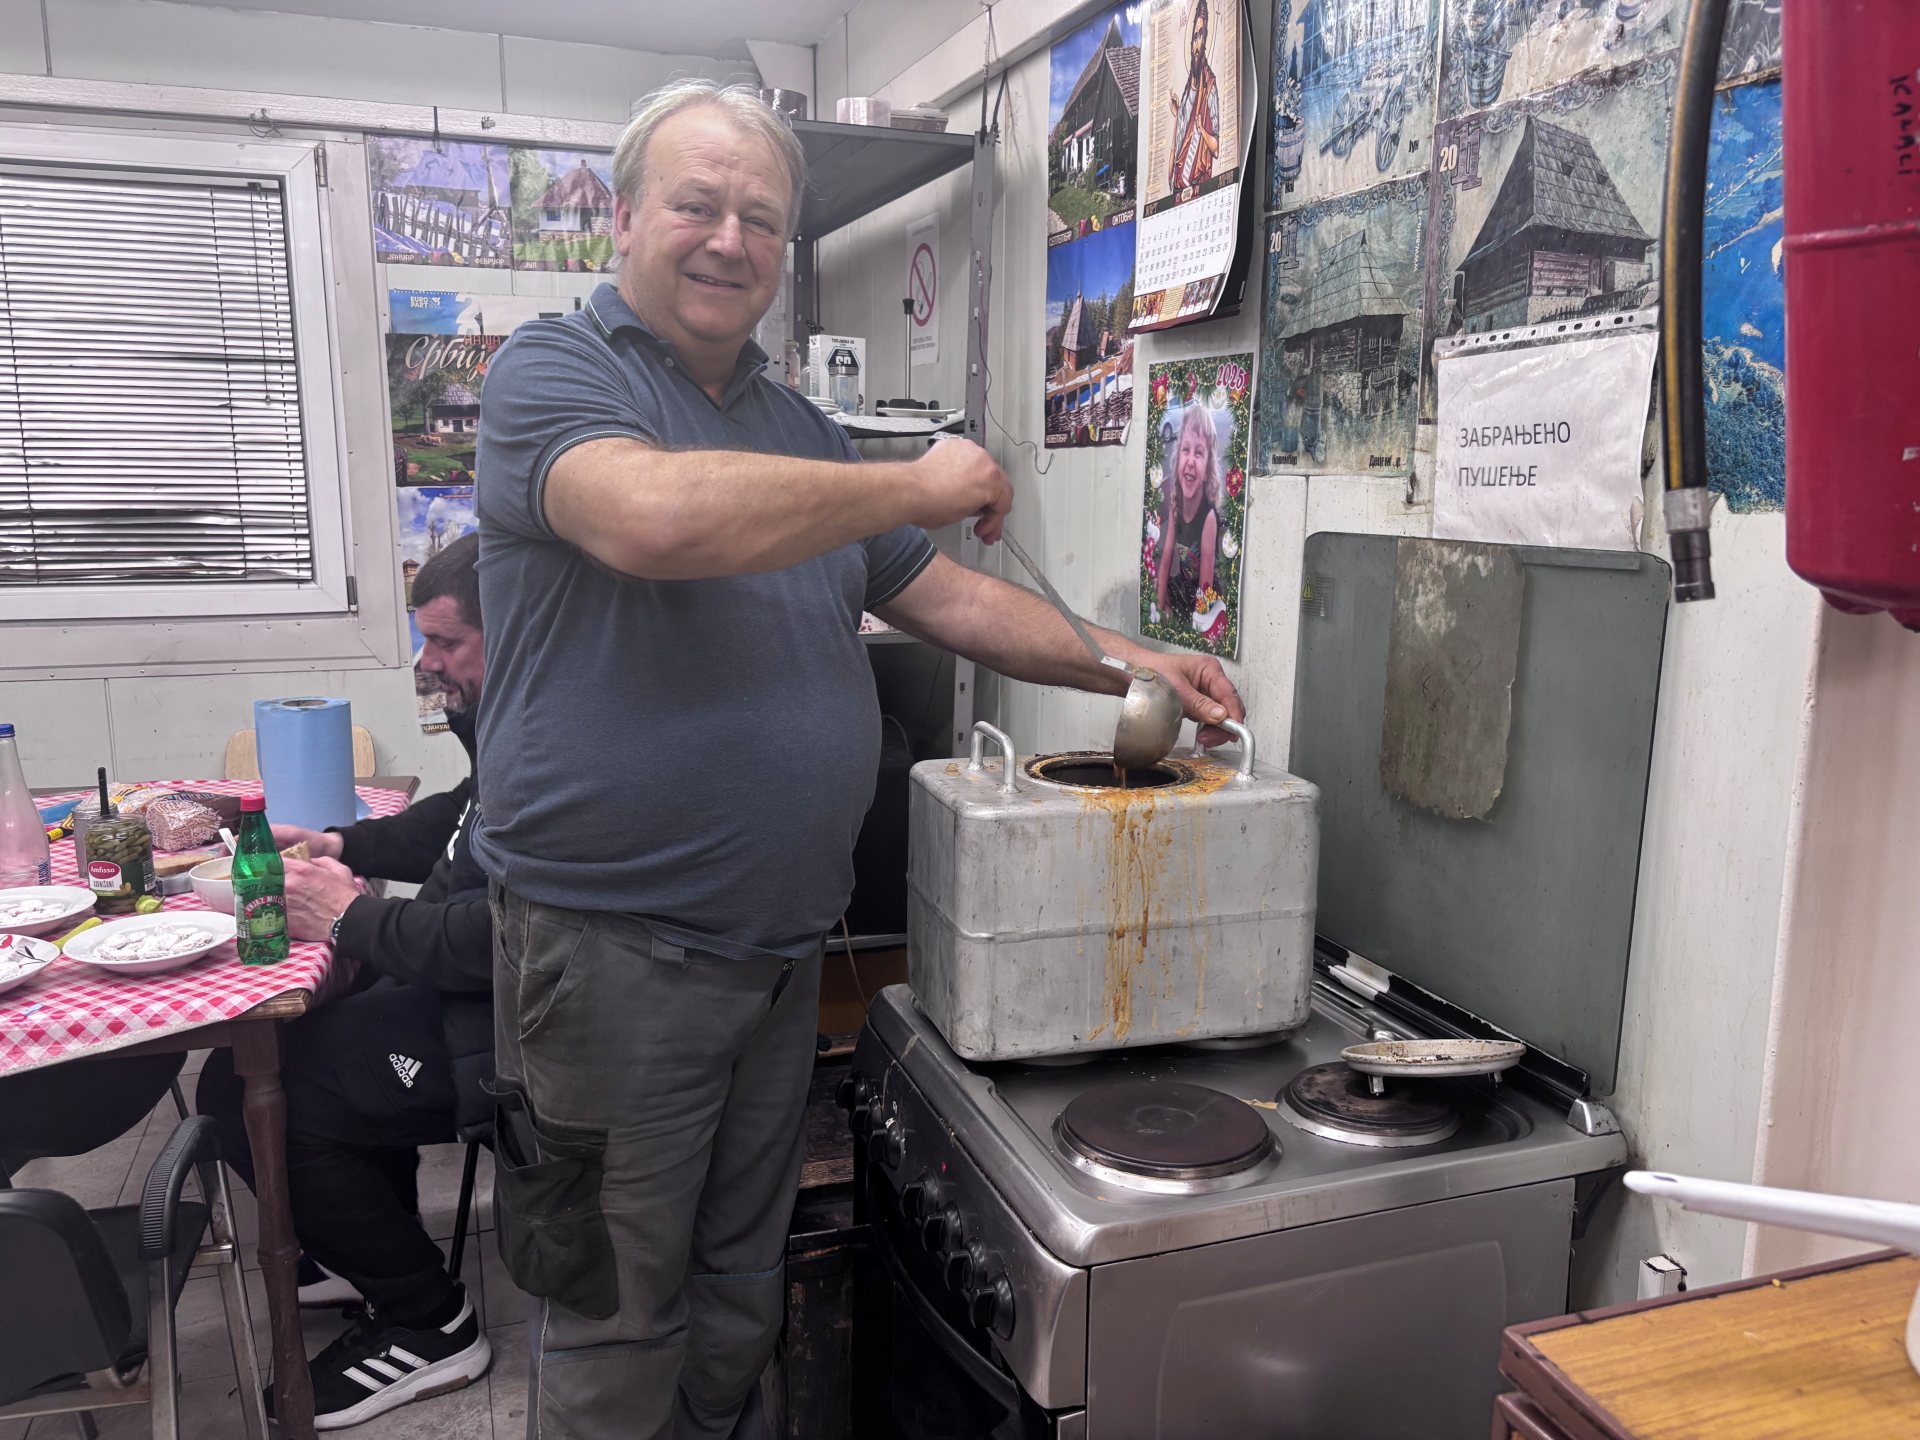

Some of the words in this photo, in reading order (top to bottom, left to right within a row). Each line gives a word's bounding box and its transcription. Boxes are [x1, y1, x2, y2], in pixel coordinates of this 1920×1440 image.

[387, 253, 415, 262] ЈАНУАР
[474, 257, 505, 266] ФЕБРУАР
[1216, 362, 1245, 390] 2025
[1460, 421, 1571, 448] ЗАБРАЊЕНО
[1458, 465, 1538, 487] ПУШЕЊЕ
[245, 897, 266, 912] KNJAZ
[389, 1053, 413, 1088] adidas
